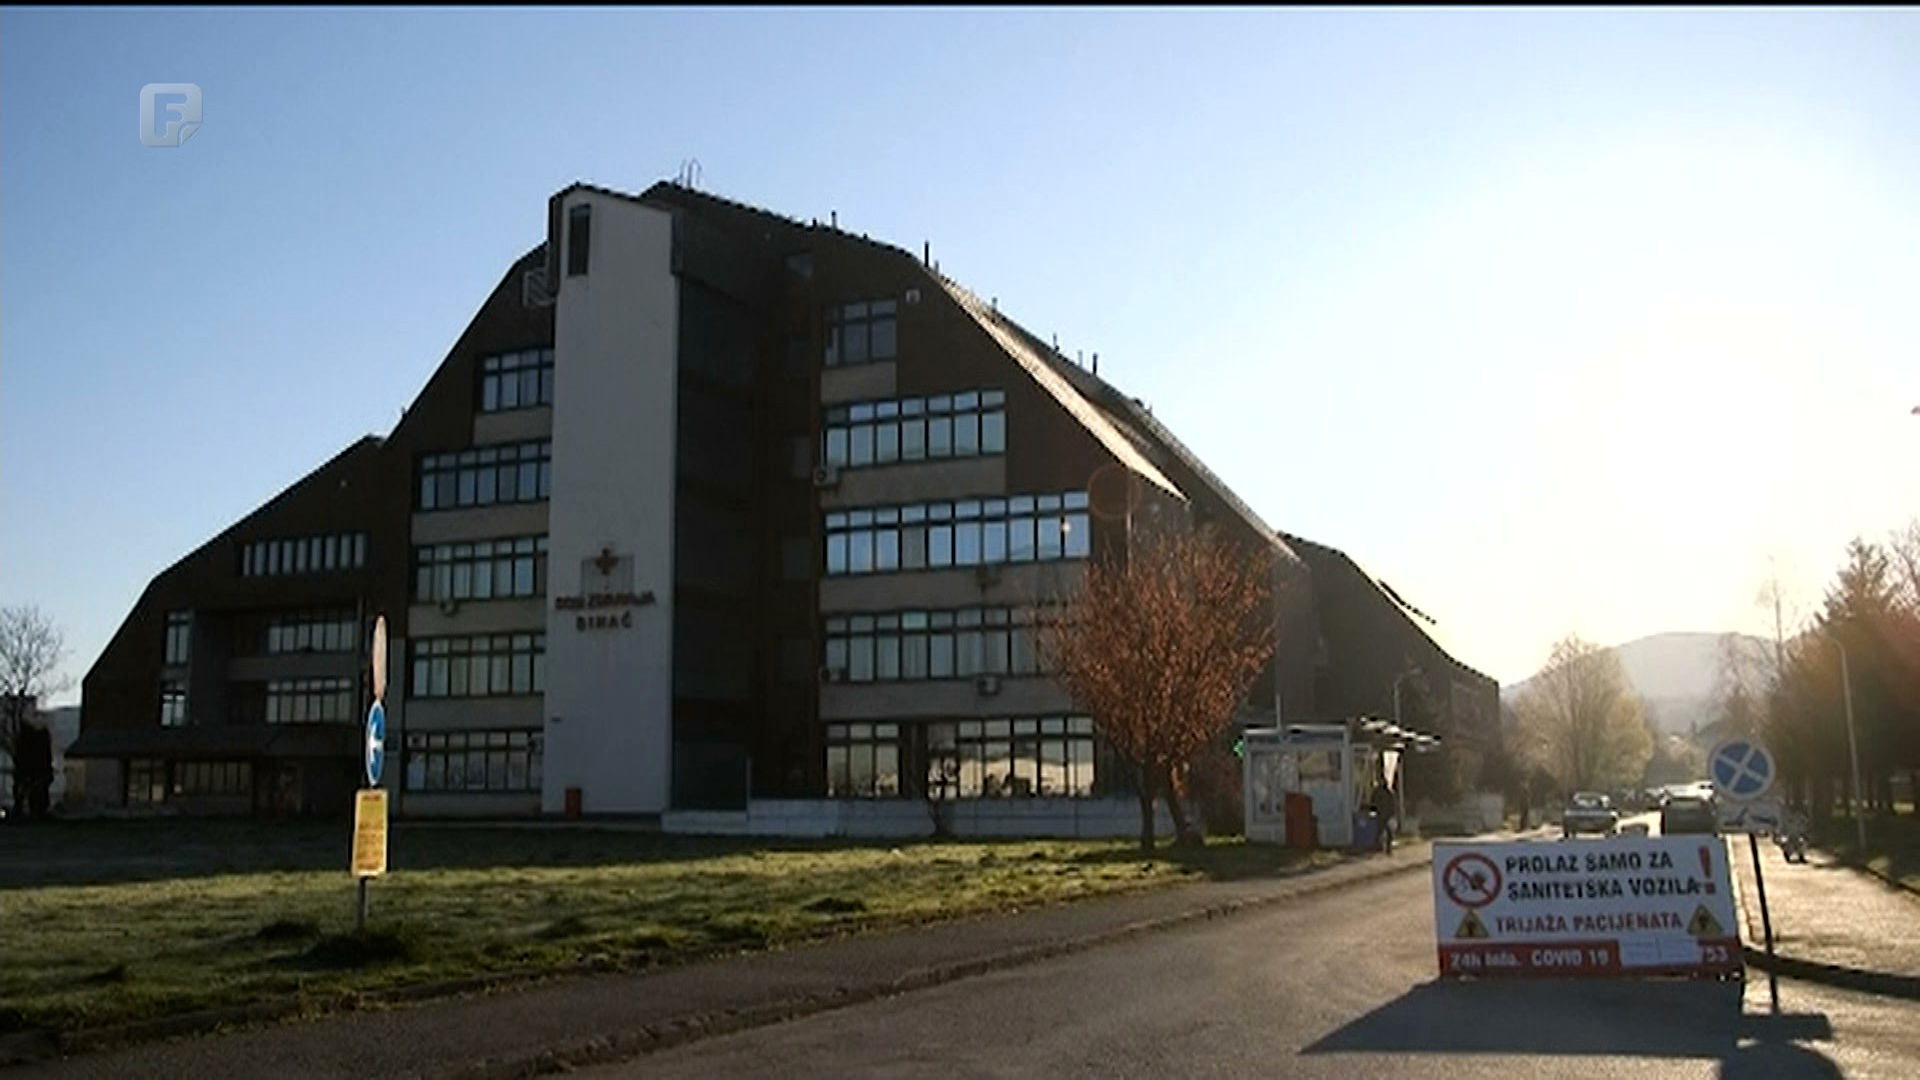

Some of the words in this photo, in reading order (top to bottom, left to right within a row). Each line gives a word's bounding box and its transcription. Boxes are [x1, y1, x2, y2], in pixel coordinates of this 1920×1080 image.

[1505, 854, 1579, 873] PROLAZ
[1585, 852, 1642, 871] SAMO
[1649, 850, 1674, 869] ZA
[1507, 877, 1624, 900] SANITETSKA
[1572, 911, 1684, 931] PACIJENATA
[1531, 949, 1583, 967] COVID
